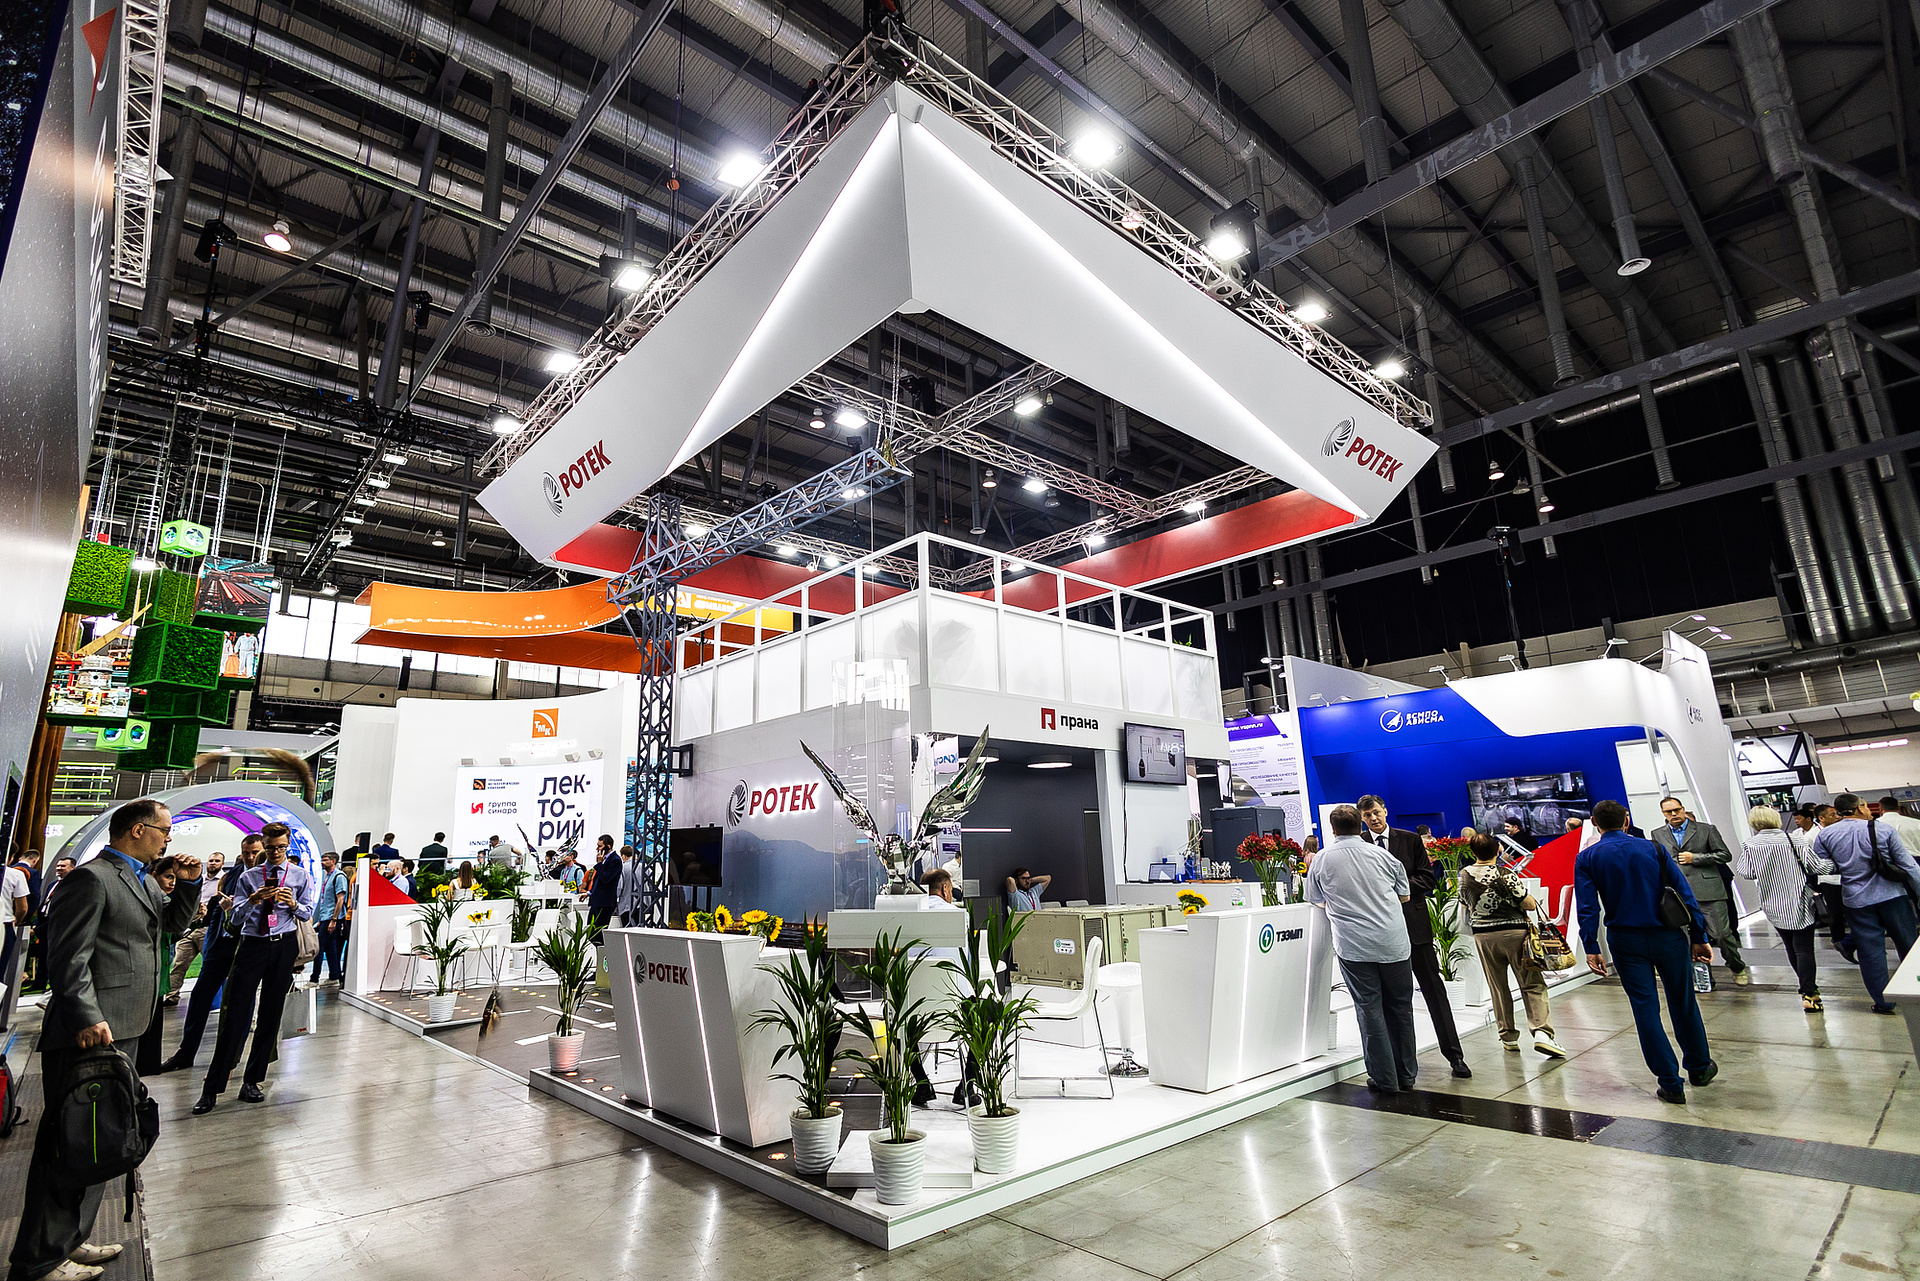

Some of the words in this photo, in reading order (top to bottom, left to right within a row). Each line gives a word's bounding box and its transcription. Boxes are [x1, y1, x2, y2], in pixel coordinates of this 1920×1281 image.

[558, 439, 612, 498] РОТЕК
[1345, 436, 1404, 483] РОТЕК
[1060, 715, 1099, 731] прана
[1405, 709, 1439, 721] ВСМПО
[1405, 714, 1445, 727] АВИСМА
[487, 807, 518, 815] синара
[748, 782, 819, 816] РОТЕК
[537, 811, 585, 847] рий
[648, 961, 689, 986] РОТЕК
